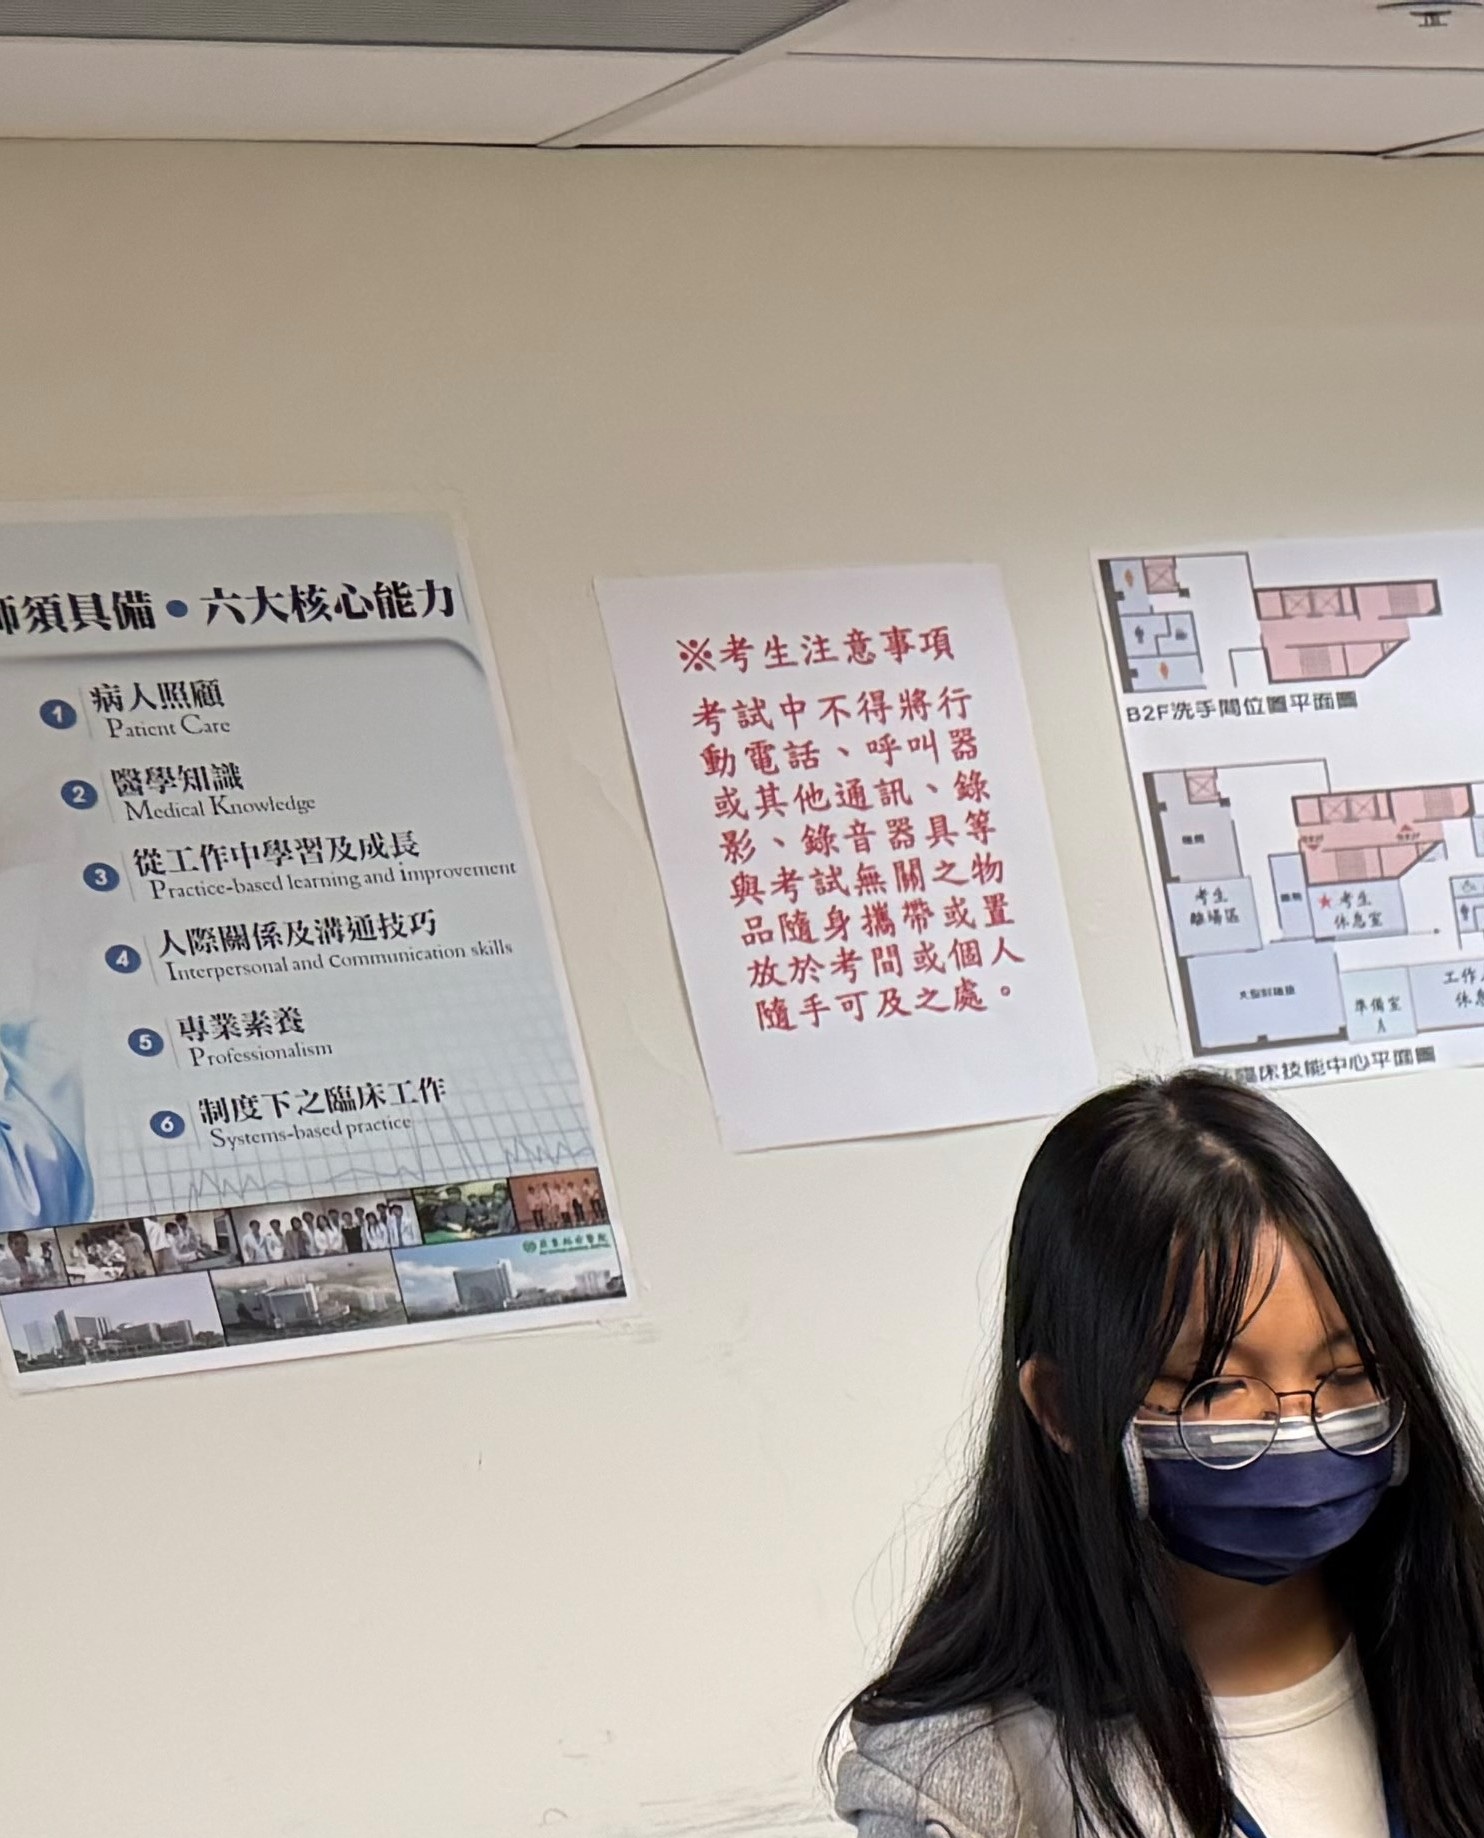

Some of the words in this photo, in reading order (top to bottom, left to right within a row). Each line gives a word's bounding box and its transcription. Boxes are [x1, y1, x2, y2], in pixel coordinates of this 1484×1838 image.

[200, 579, 456, 624] 六大核心能力
[90, 678, 226, 715] 病人照顧
[692, 684, 972, 737] 考試中不得將行
[107, 717, 177, 739] Patient
[181, 713, 231, 735] Care
[700, 727, 980, 779] 動電話、呼叫器
[112, 762, 244, 799] 醫學知識
[713, 769, 993, 821] 或其他通訊、錄
[126, 799, 206, 822] Medical
[211, 793, 316, 818] Knowledge
[134, 831, 421, 877] 從工作中學習及成長
[719, 811, 997, 865] 影、錄音器具等
[151, 871, 283, 902] Practice-based
[287, 867, 360, 893] learning
[364, 865, 396, 886] and
[399, 861, 517, 883] improvement
[729, 852, 1005, 908] 與考試無關之物
[159, 908, 438, 960] 人際關係及溝通技巧
[741, 892, 1016, 947] 品隨身攜帶或置
[166, 952, 288, 983] Interpersonal
[292, 949, 325, 972] and
[329, 941, 466, 970] Communication
[470, 939, 514, 957] skills
[178, 1006, 306, 1043] 專業素養
[755, 977, 1012, 1033] 隨手可及之處。
[190, 1041, 334, 1068] Professionalism
[200, 1076, 446, 1125] 制度下之臨床工作
[211, 1115, 342, 1151] Systems-based
[346, 1113, 413, 1139] practice
